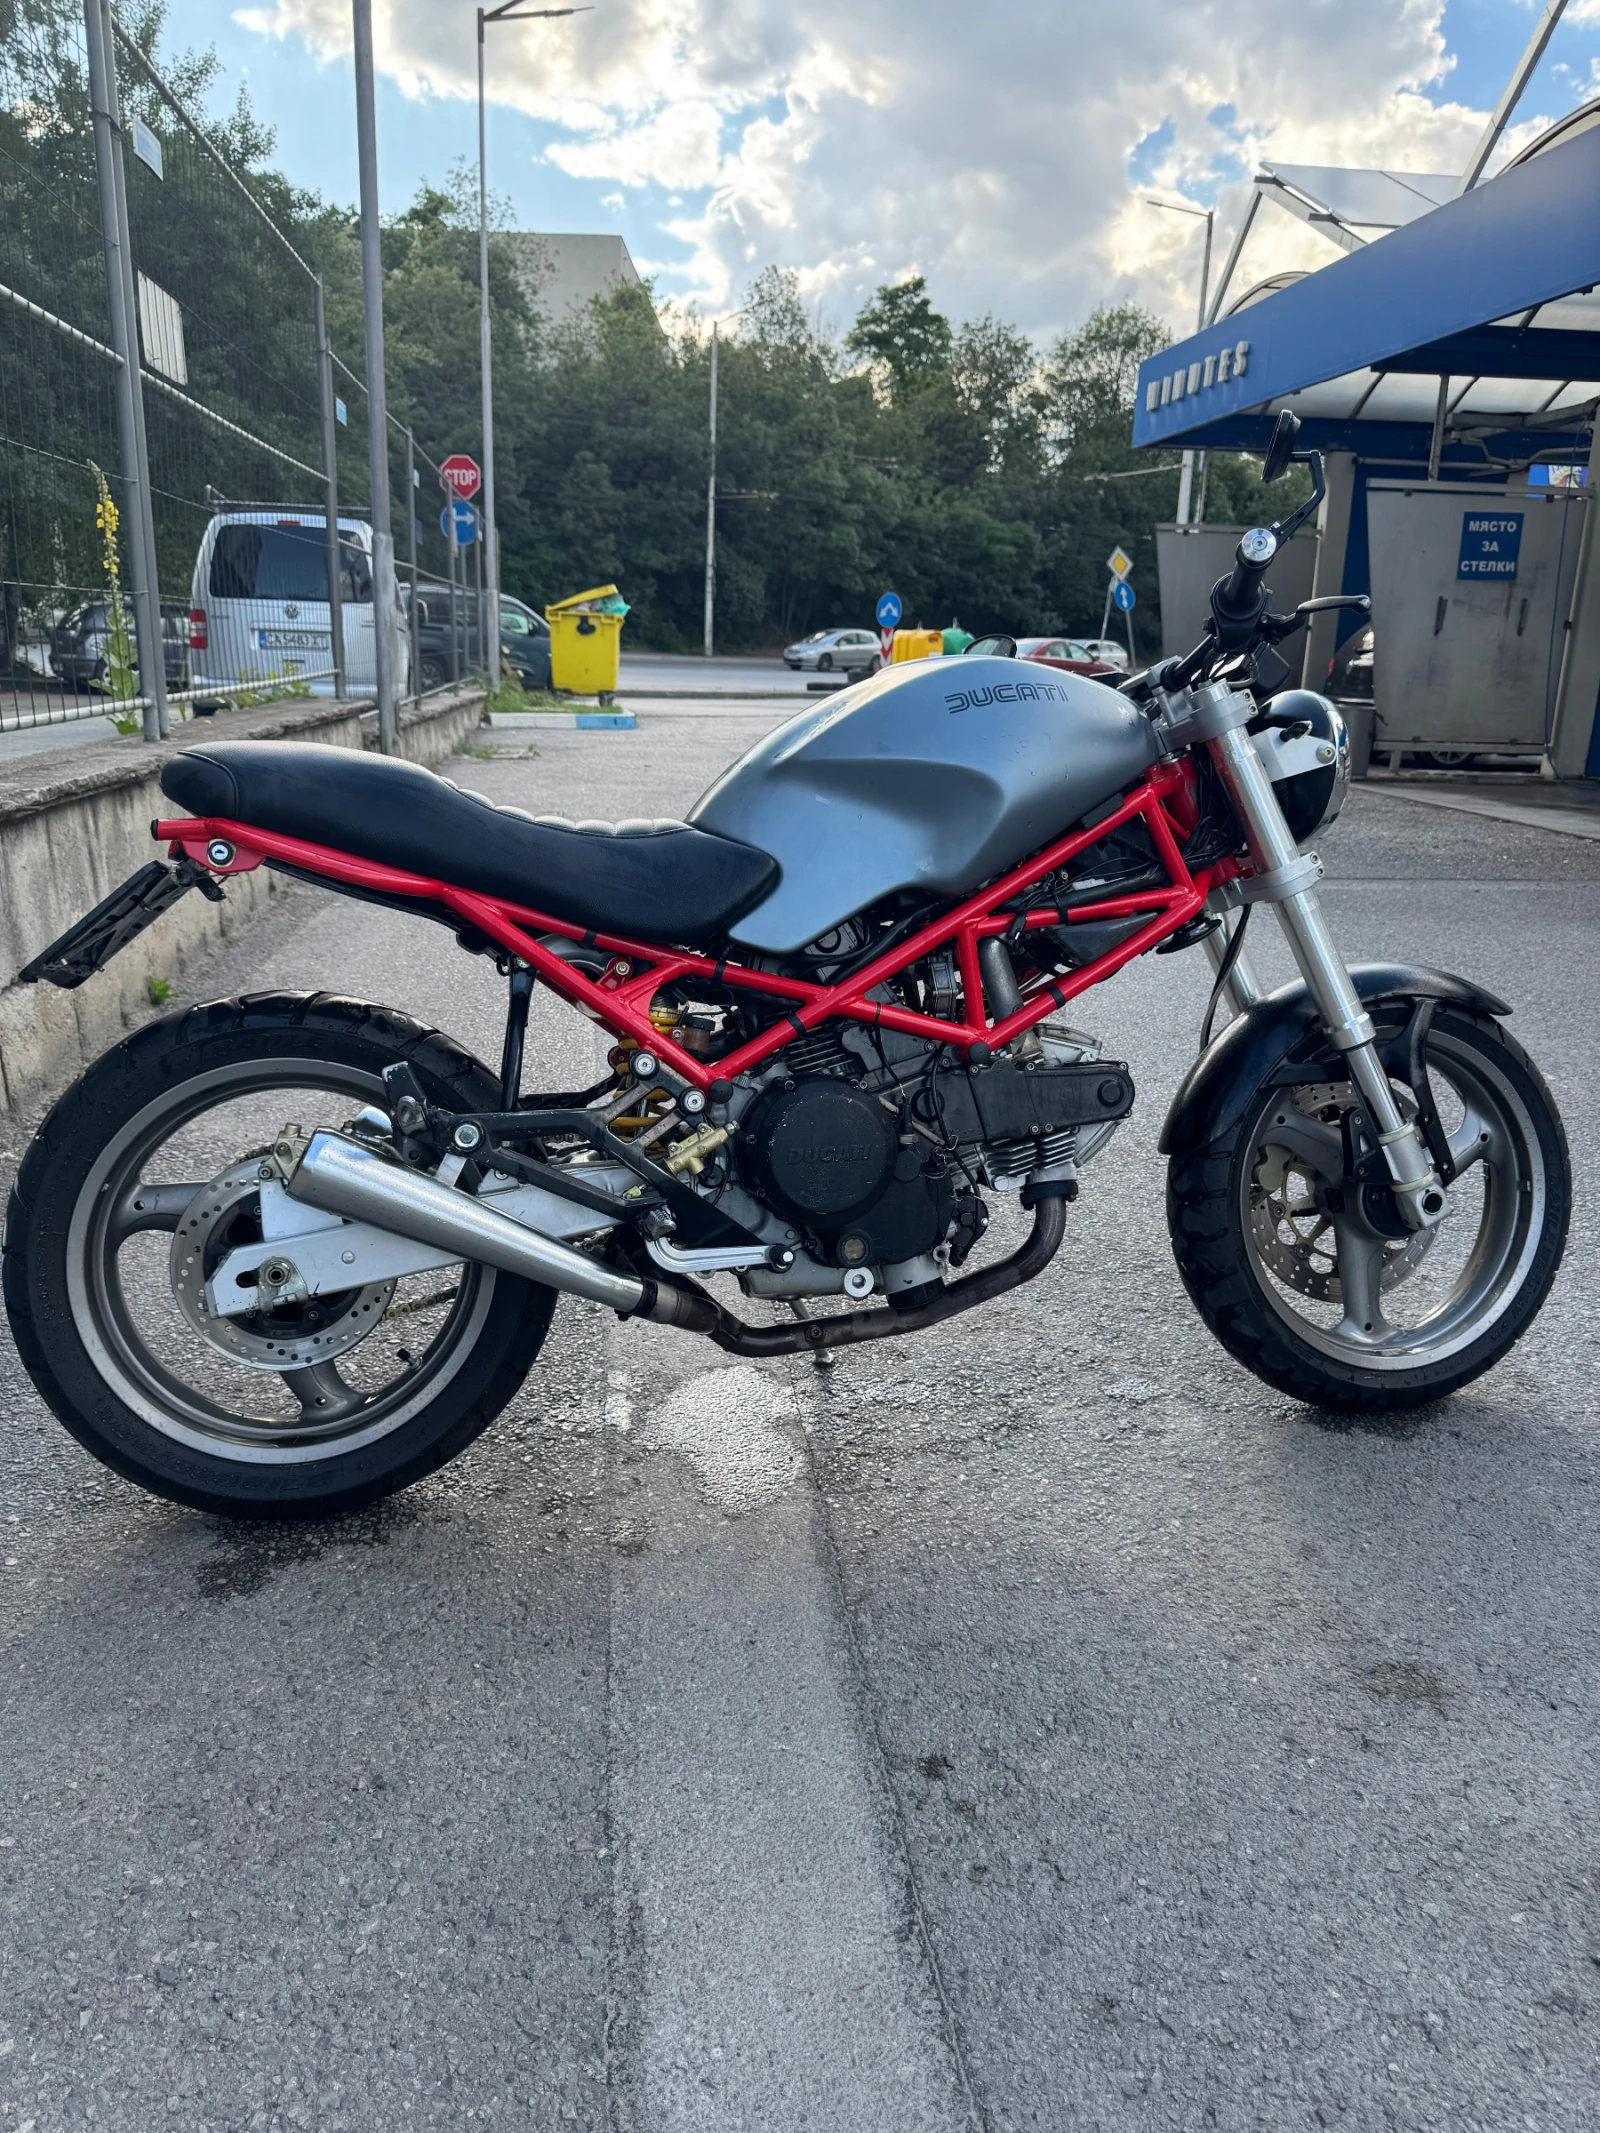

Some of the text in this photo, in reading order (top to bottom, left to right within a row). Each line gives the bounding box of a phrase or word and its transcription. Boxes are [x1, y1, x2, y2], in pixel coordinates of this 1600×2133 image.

[445, 469, 477, 486] STOP
[1468, 520, 1517, 533] МЯСТО
[1481, 540, 1499, 552] ЗА
[1460, 560, 1515, 572] СТЕЛКИ
[944, 683, 1069, 714] DUCATI
[786, 1144, 871, 1165] DUCATI
